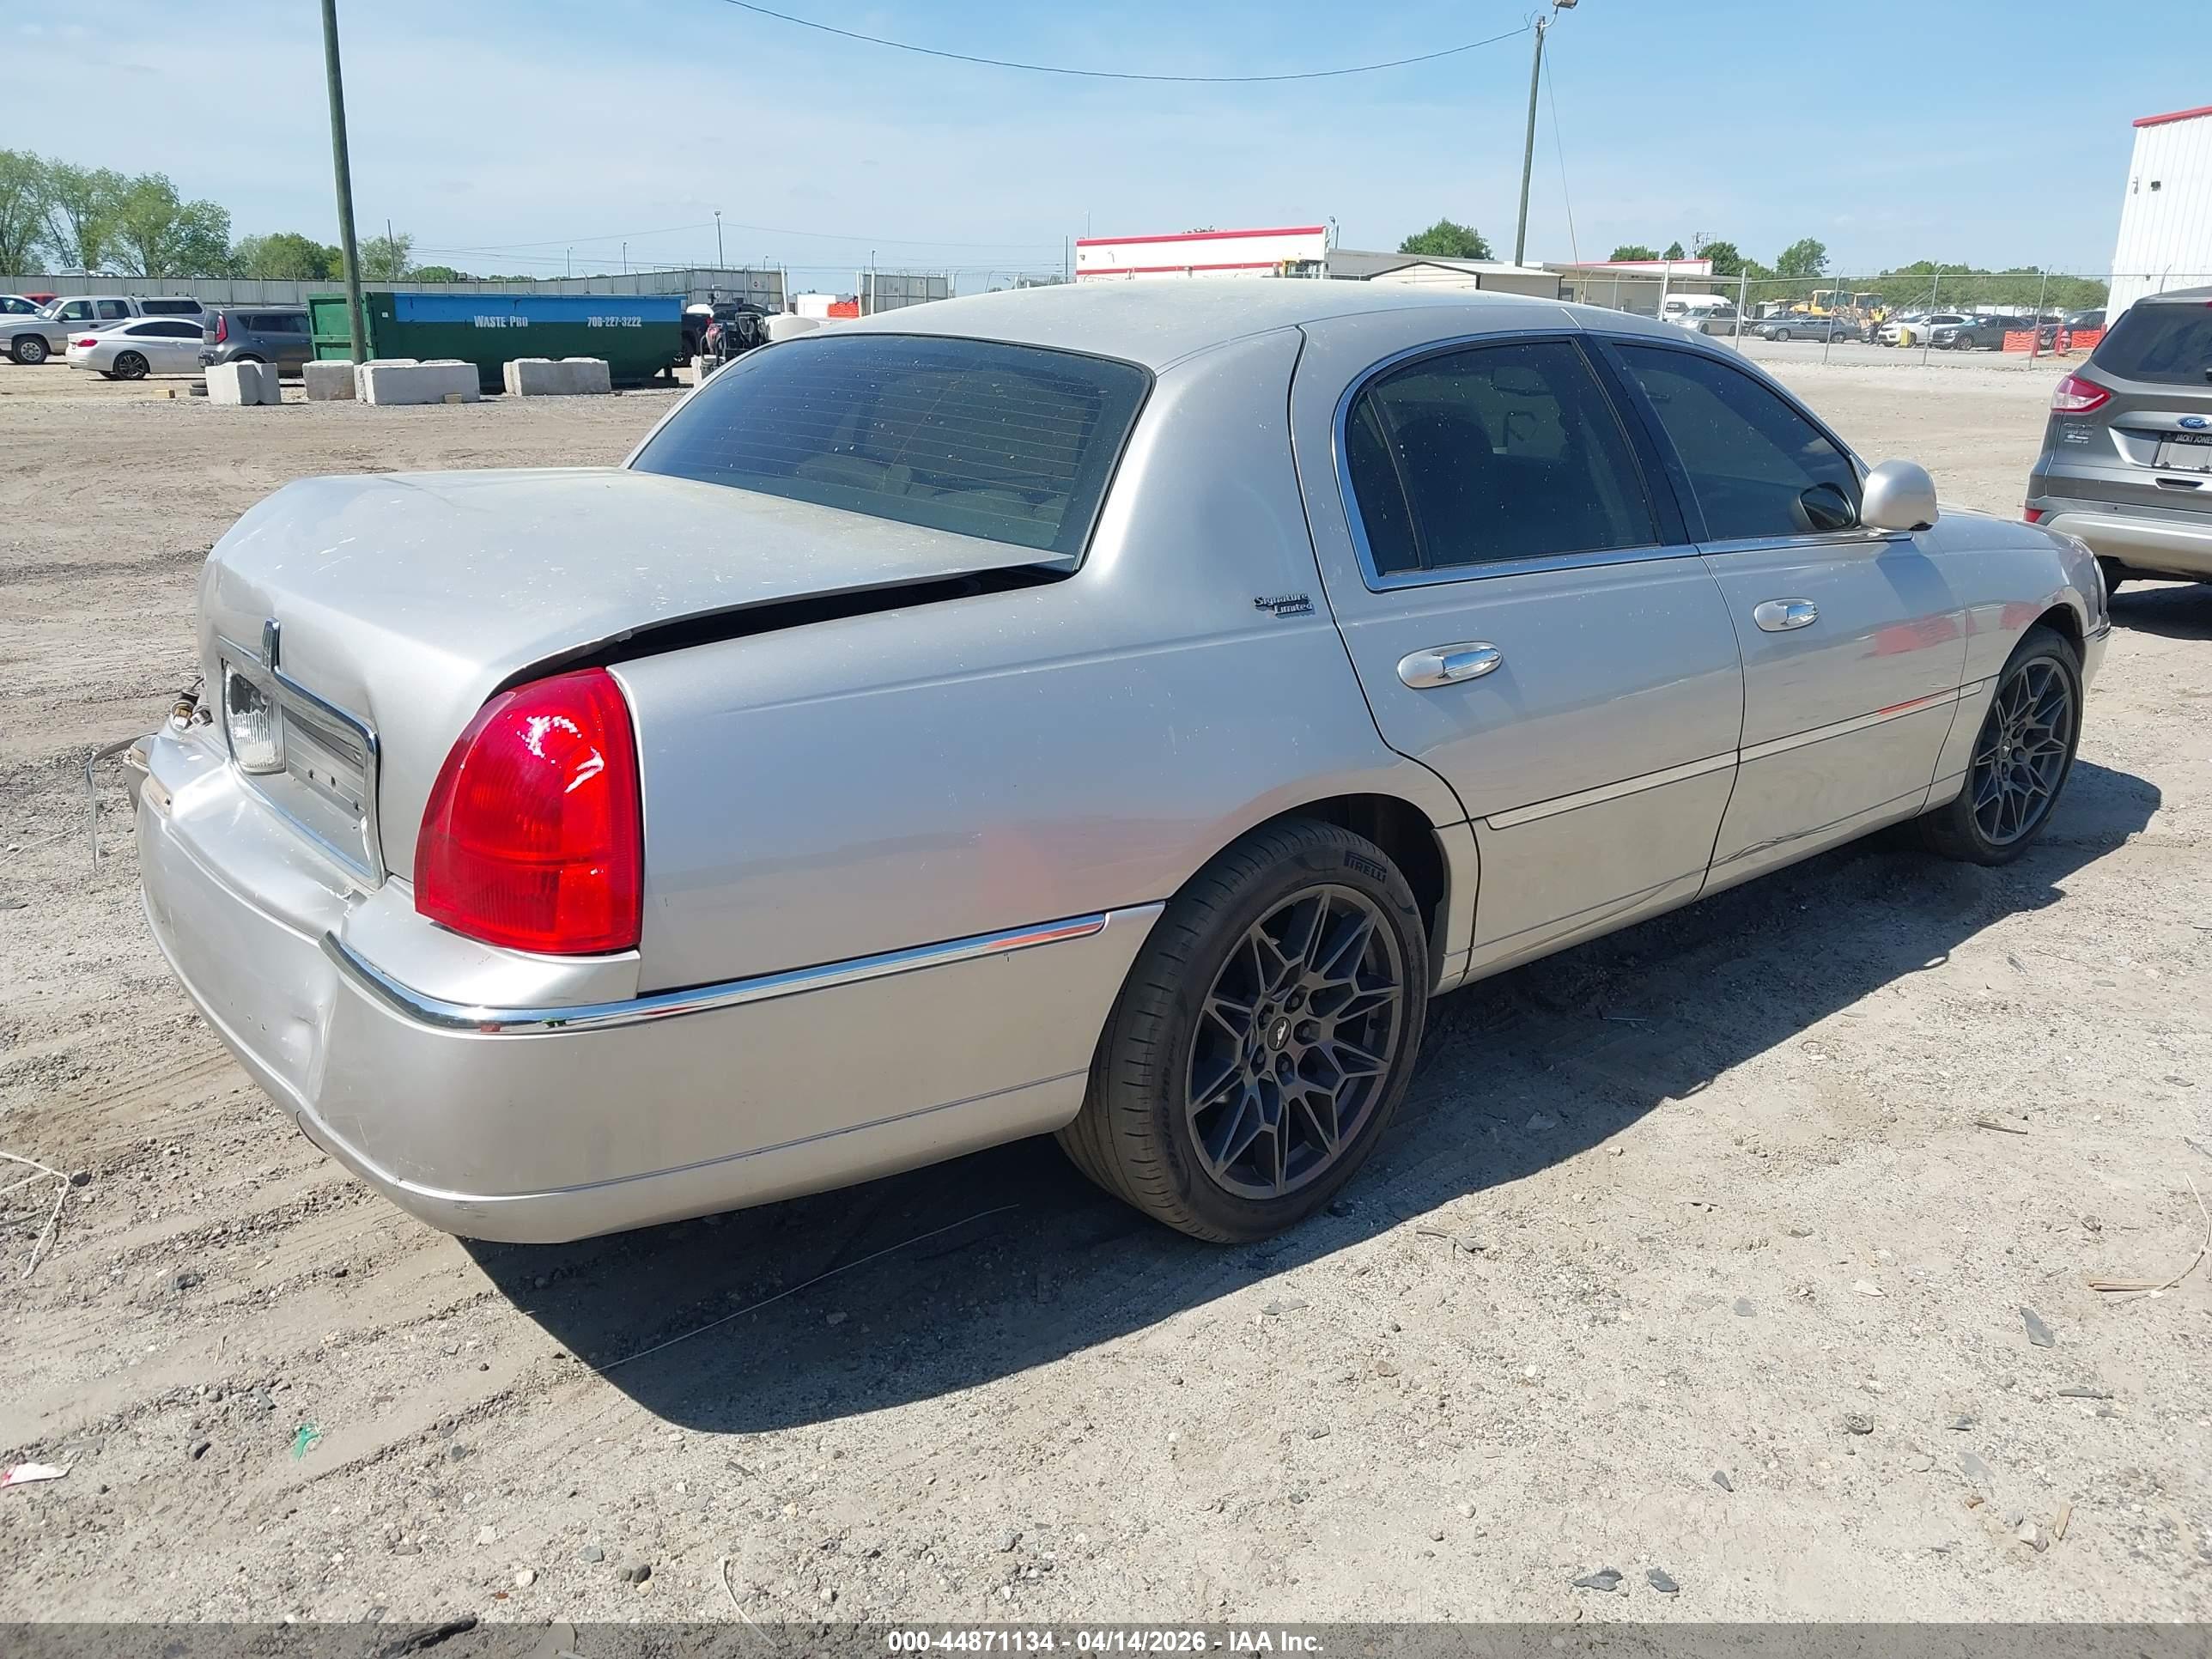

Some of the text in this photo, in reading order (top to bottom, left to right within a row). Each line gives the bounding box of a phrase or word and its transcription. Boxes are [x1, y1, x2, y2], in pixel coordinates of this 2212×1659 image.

[586, 316, 642, 327] 706-227-3222
[1254, 592, 1309, 606] Signature
[1273, 602, 1313, 614] Limited
[1344, 850, 1387, 884] PIRELLI
